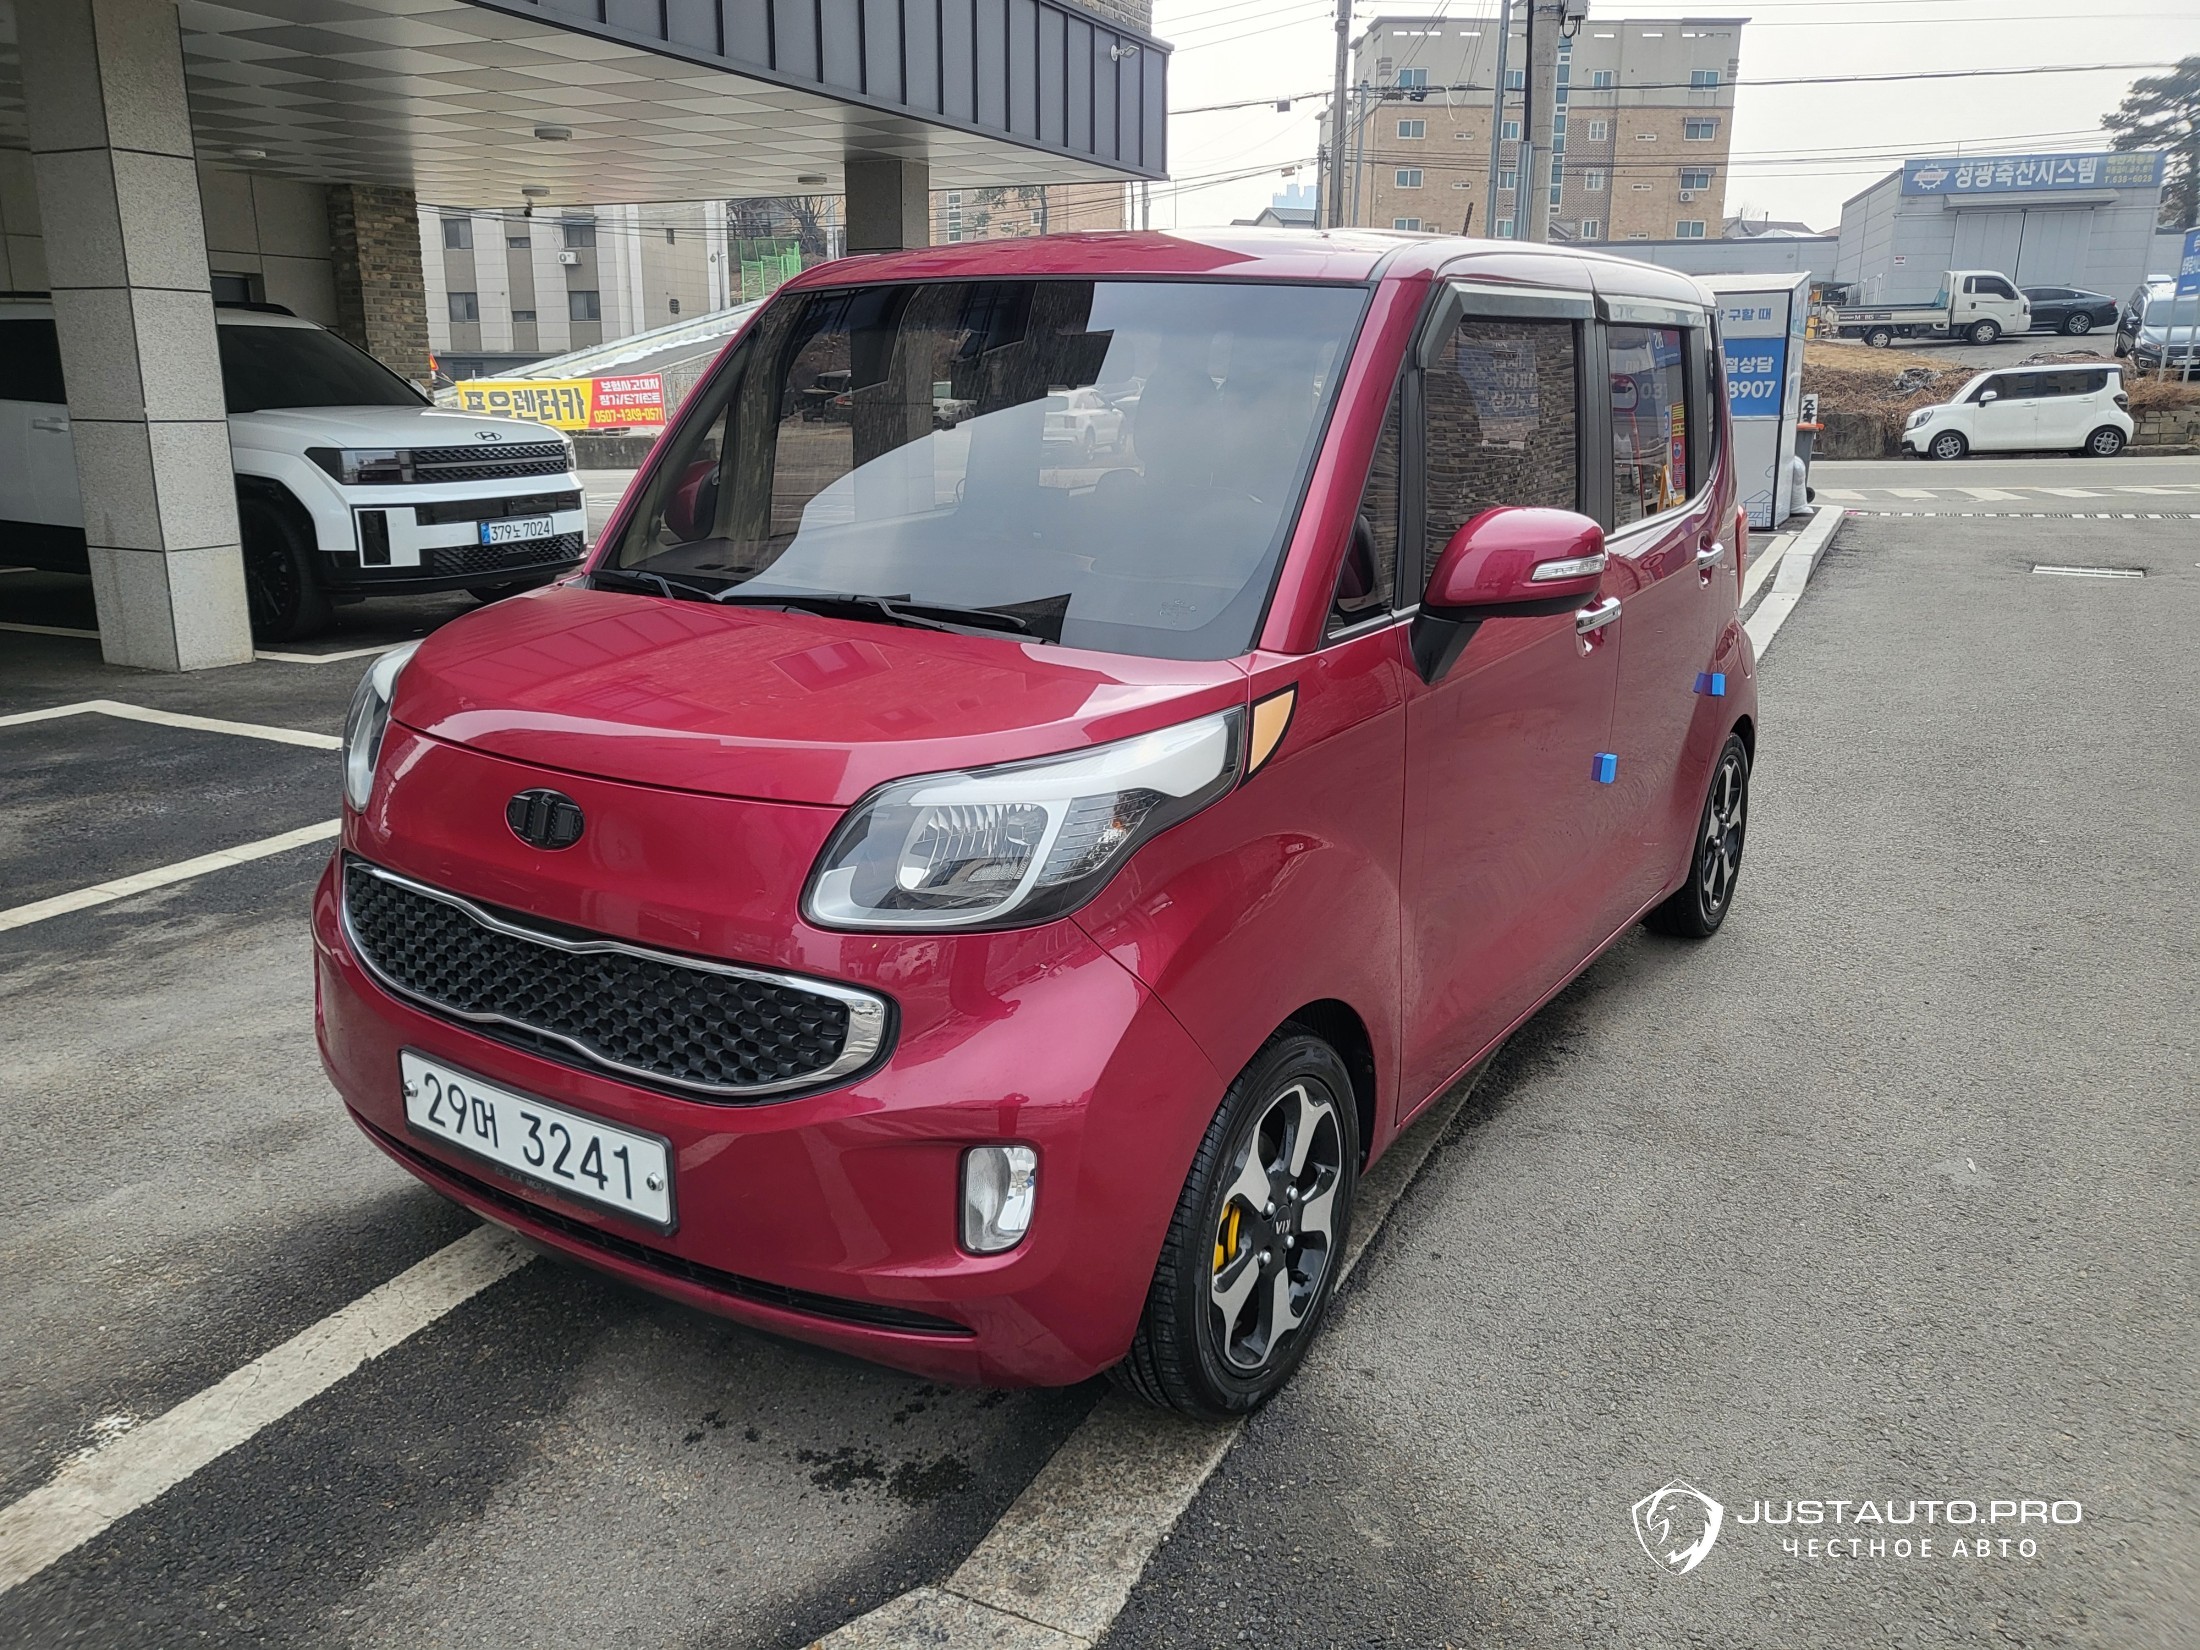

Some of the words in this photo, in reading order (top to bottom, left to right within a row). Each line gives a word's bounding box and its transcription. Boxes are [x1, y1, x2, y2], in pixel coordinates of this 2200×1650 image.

[1954, 157, 2098, 188] 성광축산시스템
[1728, 308, 1755, 321] 구할
[1758, 307, 1772, 320] 때
[491, 524, 521, 541] 379노
[523, 520, 550, 537] 7024
[424, 1072, 499, 1149] 29머
[520, 1111, 633, 1200] 3241
